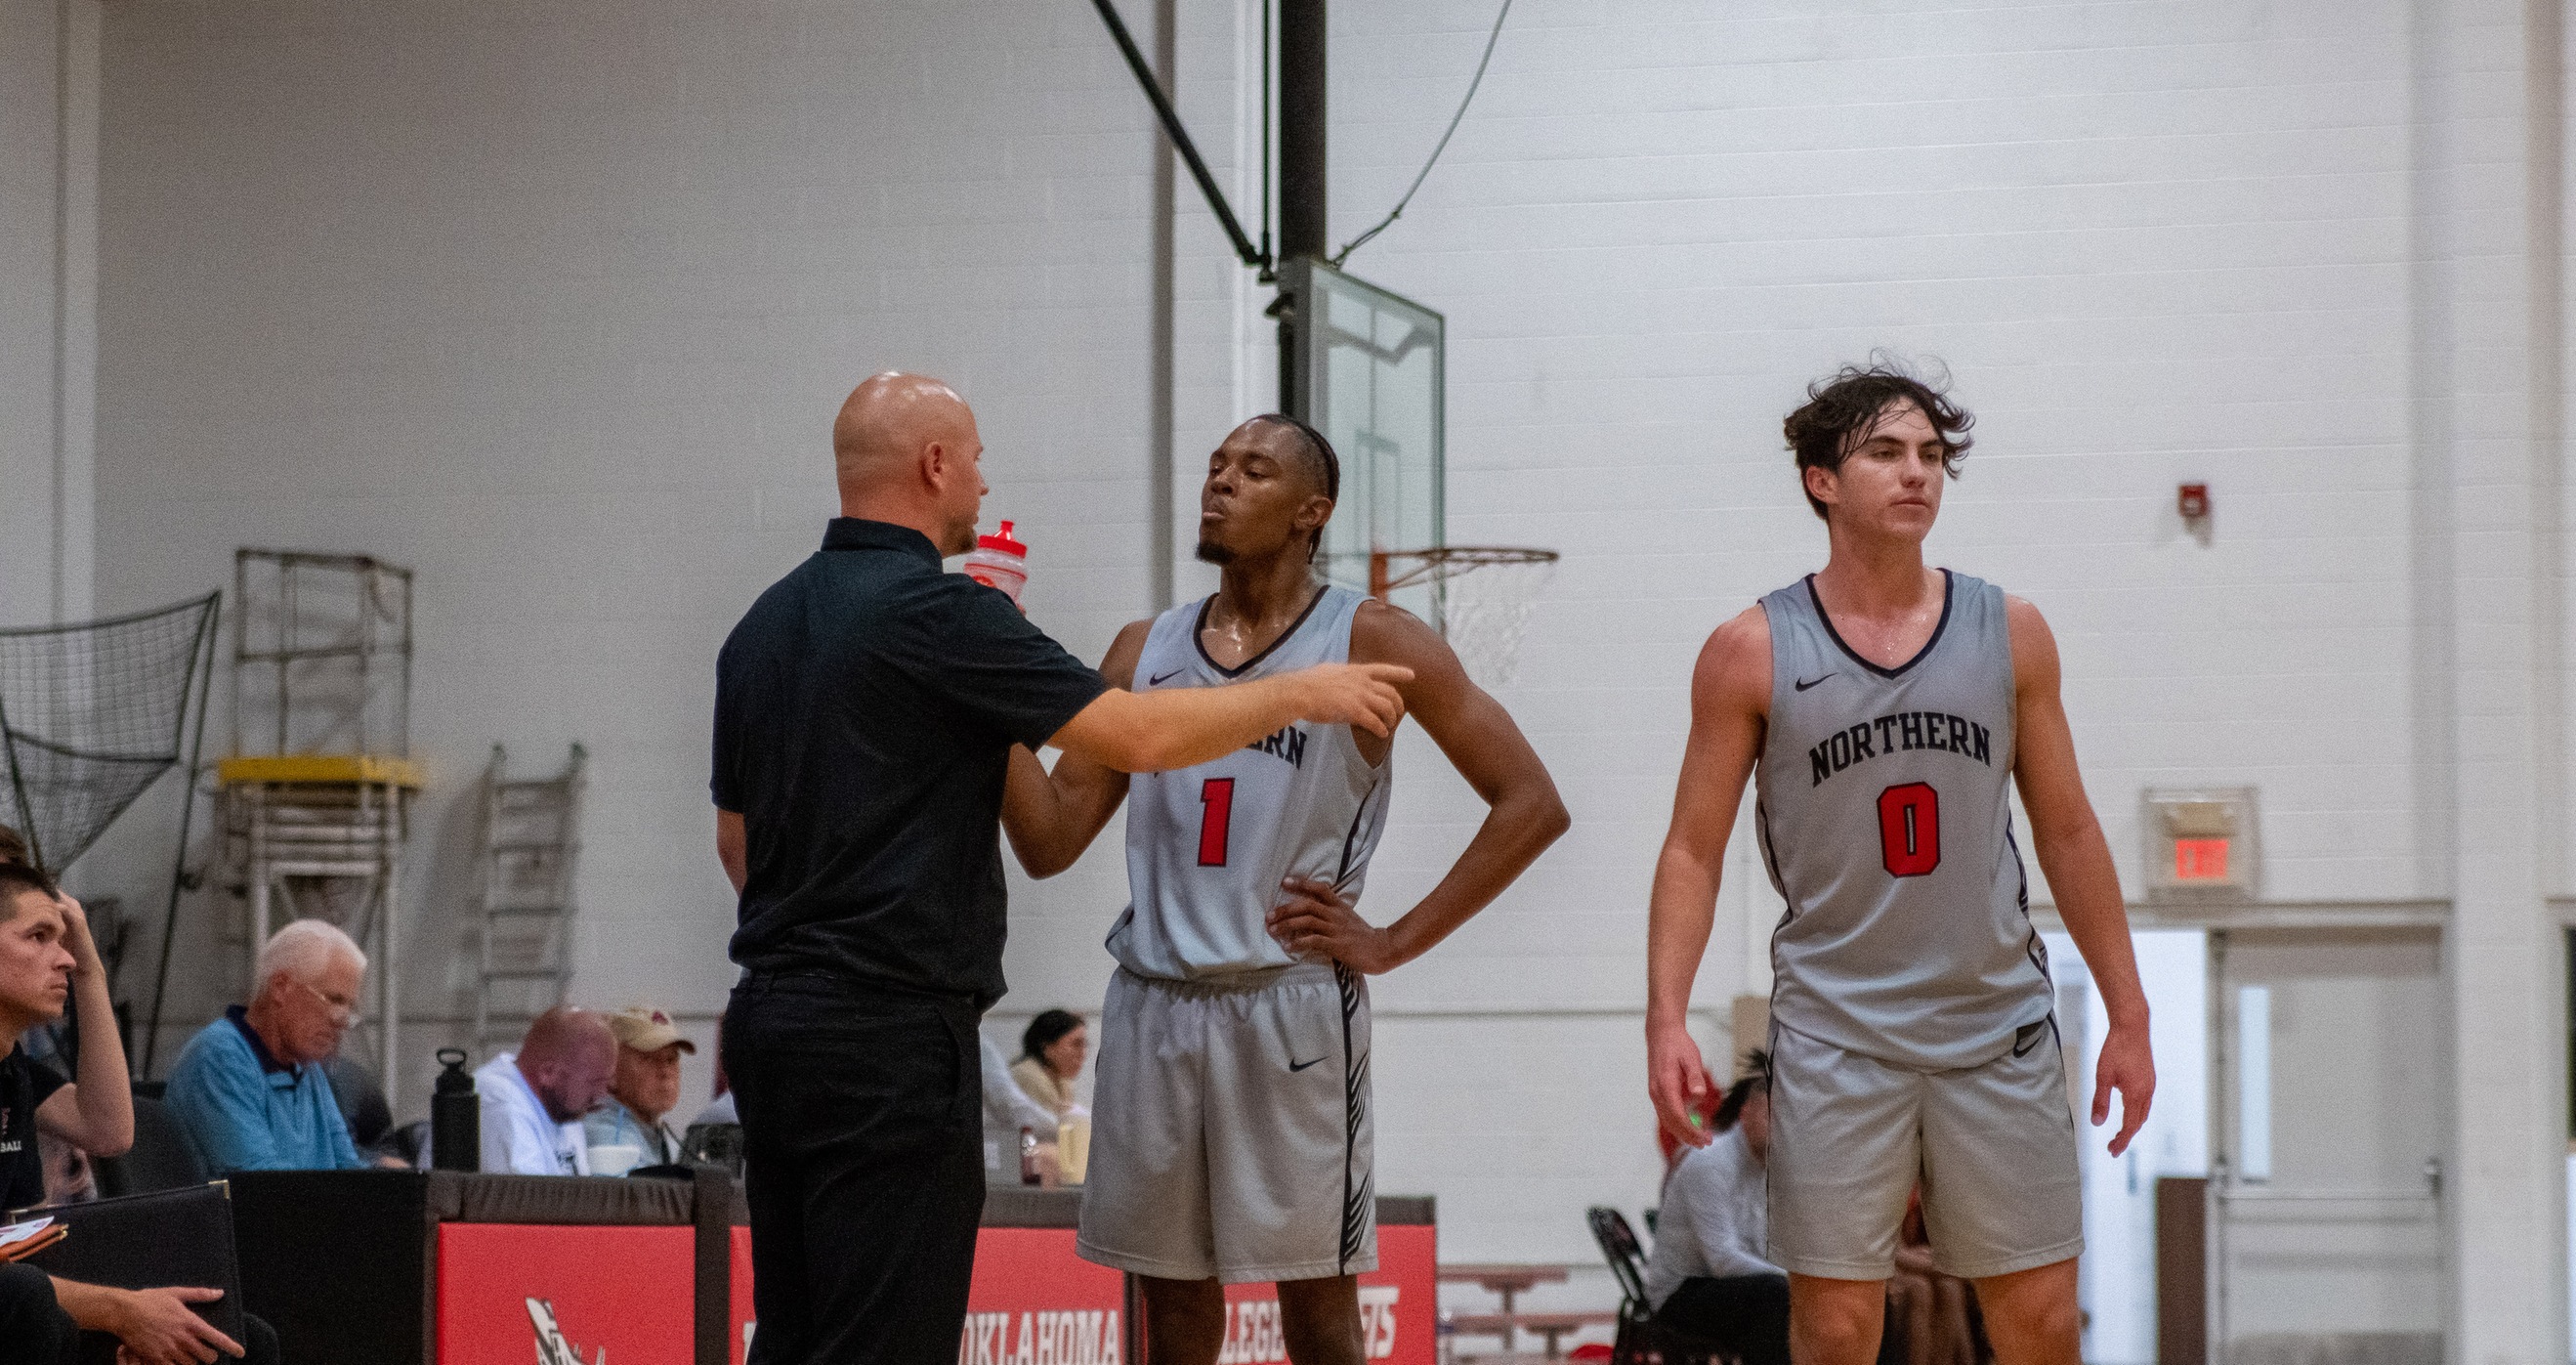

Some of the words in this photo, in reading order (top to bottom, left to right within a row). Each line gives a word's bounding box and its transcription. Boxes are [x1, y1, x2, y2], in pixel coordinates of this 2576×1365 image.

[1809, 711, 1991, 789] NORTHERN
[1198, 778, 1235, 867] 1
[1877, 782, 1941, 878] 0
